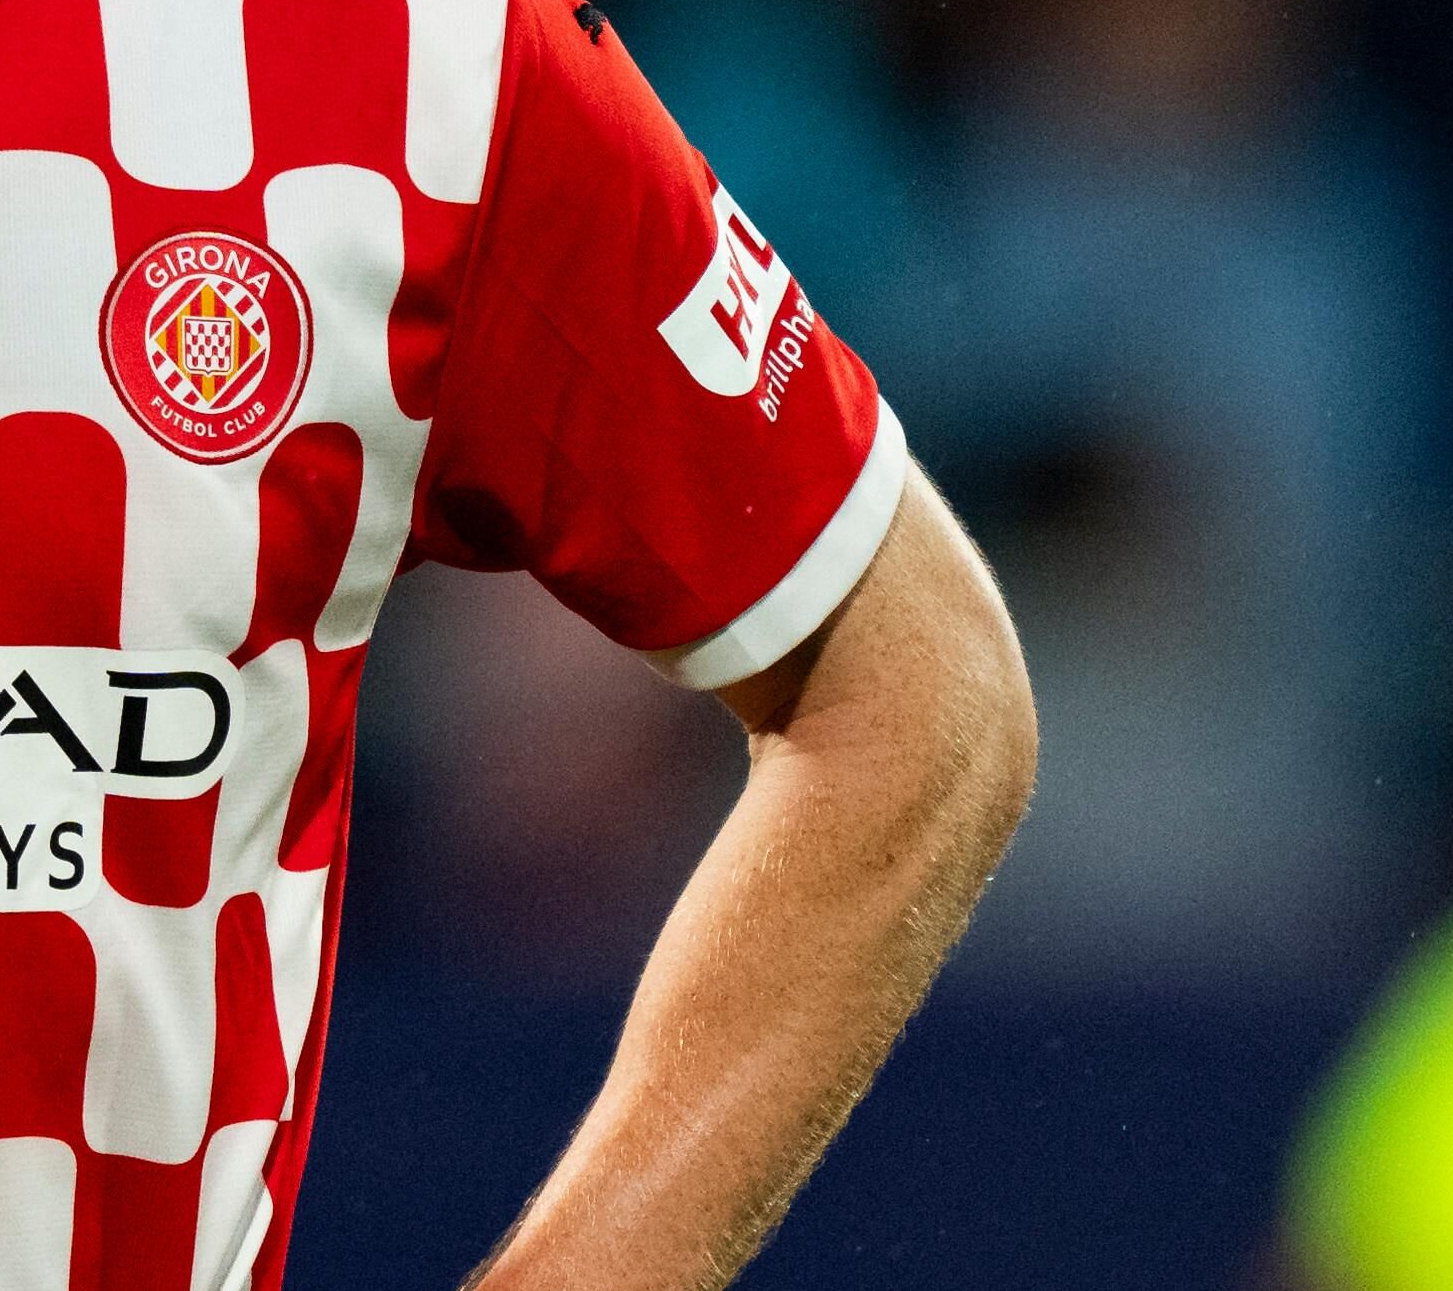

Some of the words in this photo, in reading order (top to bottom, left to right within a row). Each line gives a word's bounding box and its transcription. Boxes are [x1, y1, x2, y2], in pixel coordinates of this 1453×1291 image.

[145, 245, 271, 299] GIRONA
[151, 395, 218, 438] FUTBOL
[224, 401, 266, 434] CLUB
